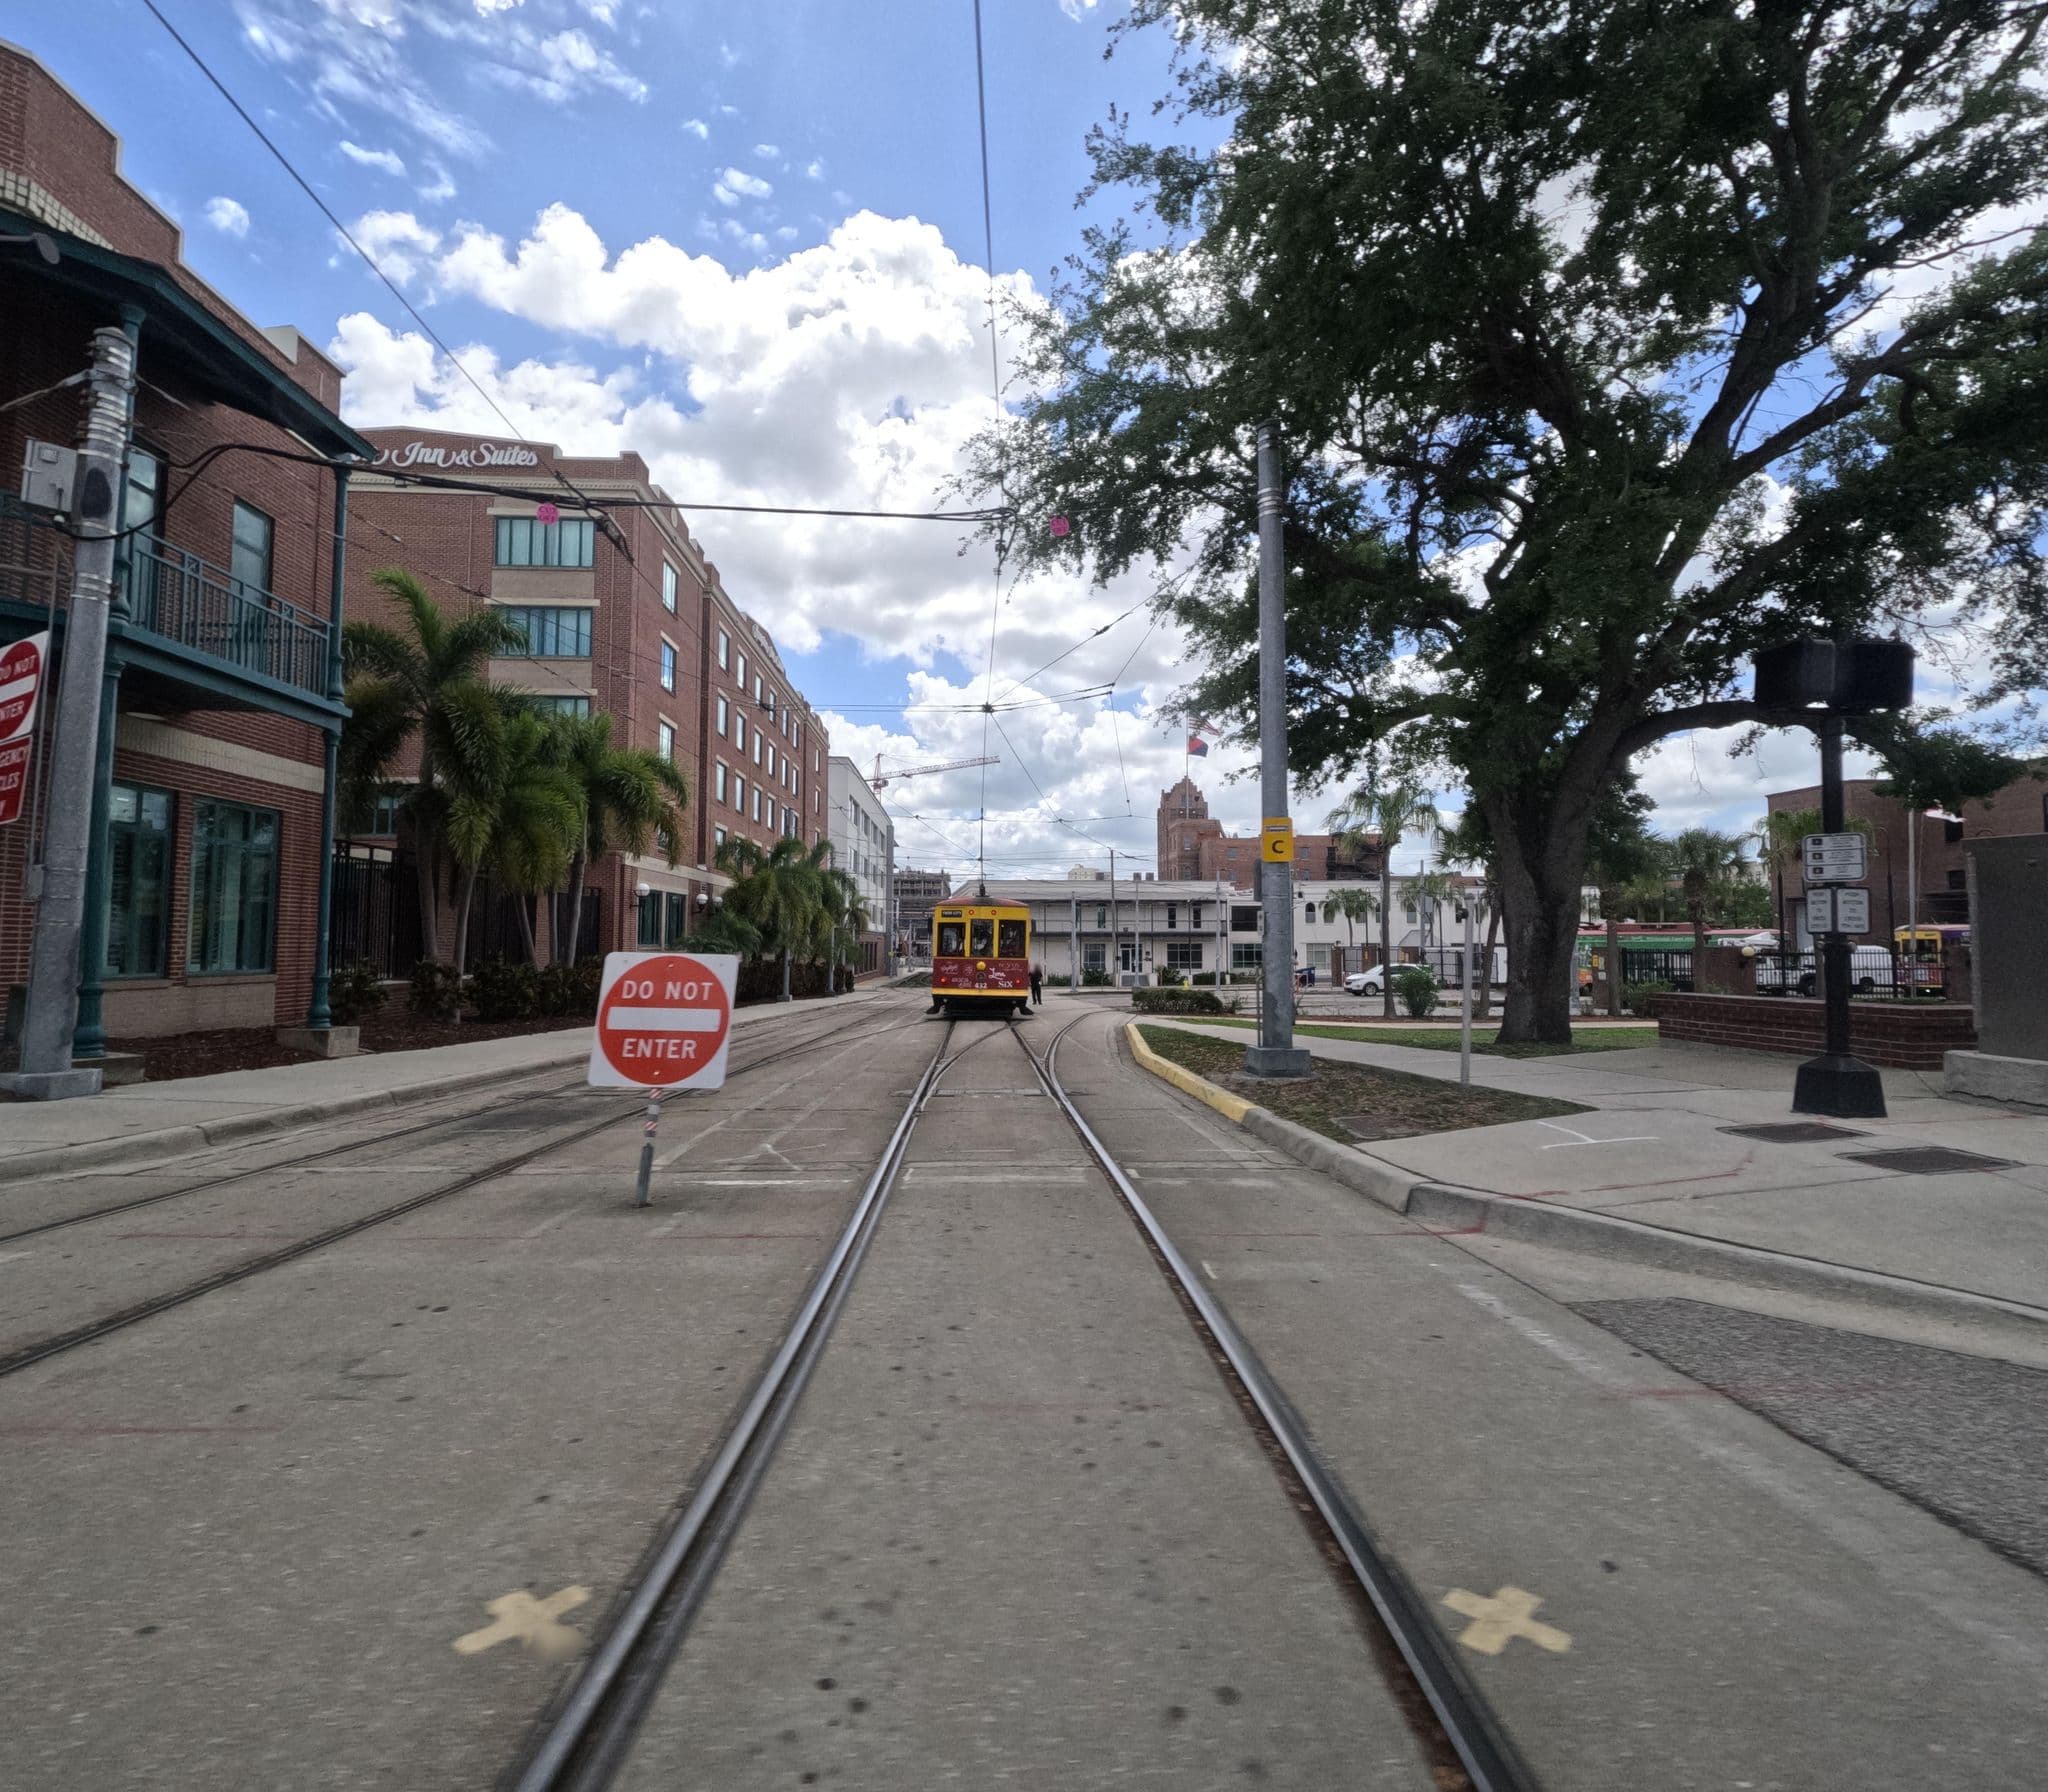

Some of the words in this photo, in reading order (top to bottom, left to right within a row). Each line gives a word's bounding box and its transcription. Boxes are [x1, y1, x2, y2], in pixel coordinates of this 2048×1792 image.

[391, 441, 456, 468] Inn
[455, 450, 472, 468] &
[470, 443, 538, 466] Suites
[0, 700, 24, 721] NTER
[1271, 840, 1285, 854] C
[621, 980, 654, 1000] DO
[664, 981, 713, 1001] NOT
[621, 1038, 697, 1059] ENTER
